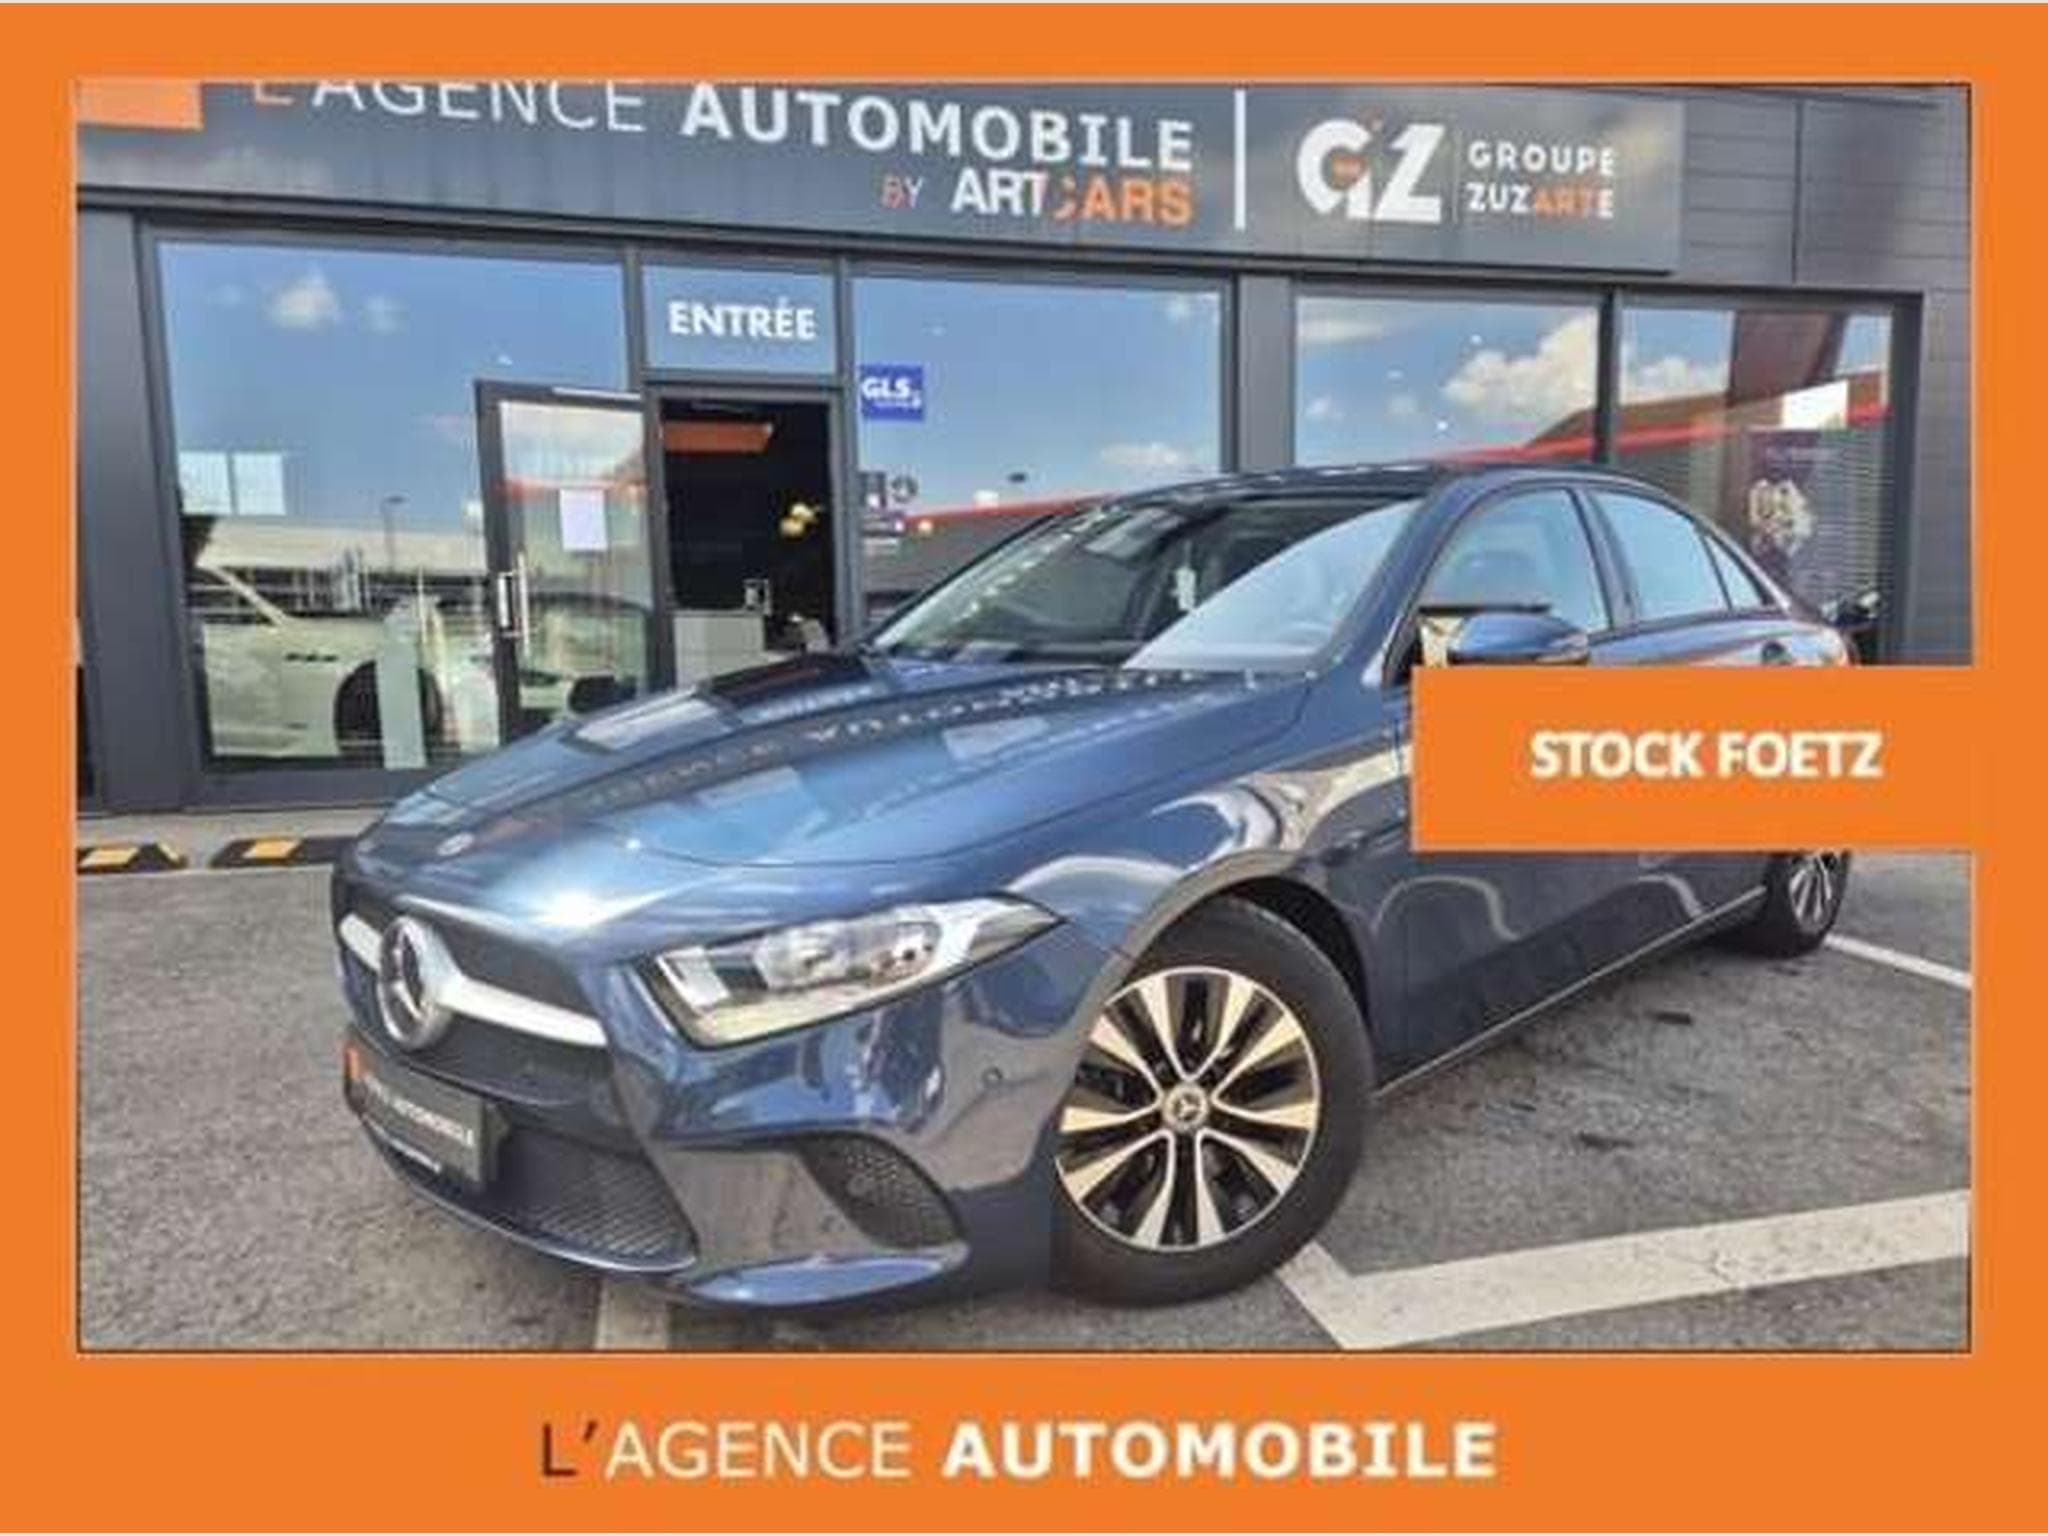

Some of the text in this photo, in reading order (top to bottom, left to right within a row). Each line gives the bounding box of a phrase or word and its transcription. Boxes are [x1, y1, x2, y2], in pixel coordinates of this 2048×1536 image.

[253, 79, 1195, 172] LAGENCE AUTOMOBILE
[1467, 140, 1616, 178] GROUPE
[881, 174, 925, 209] BY
[1464, 182, 1615, 220] ZUZARTE
[667, 295, 818, 341] ENTRÉE
[861, 376, 911, 400] GLS
